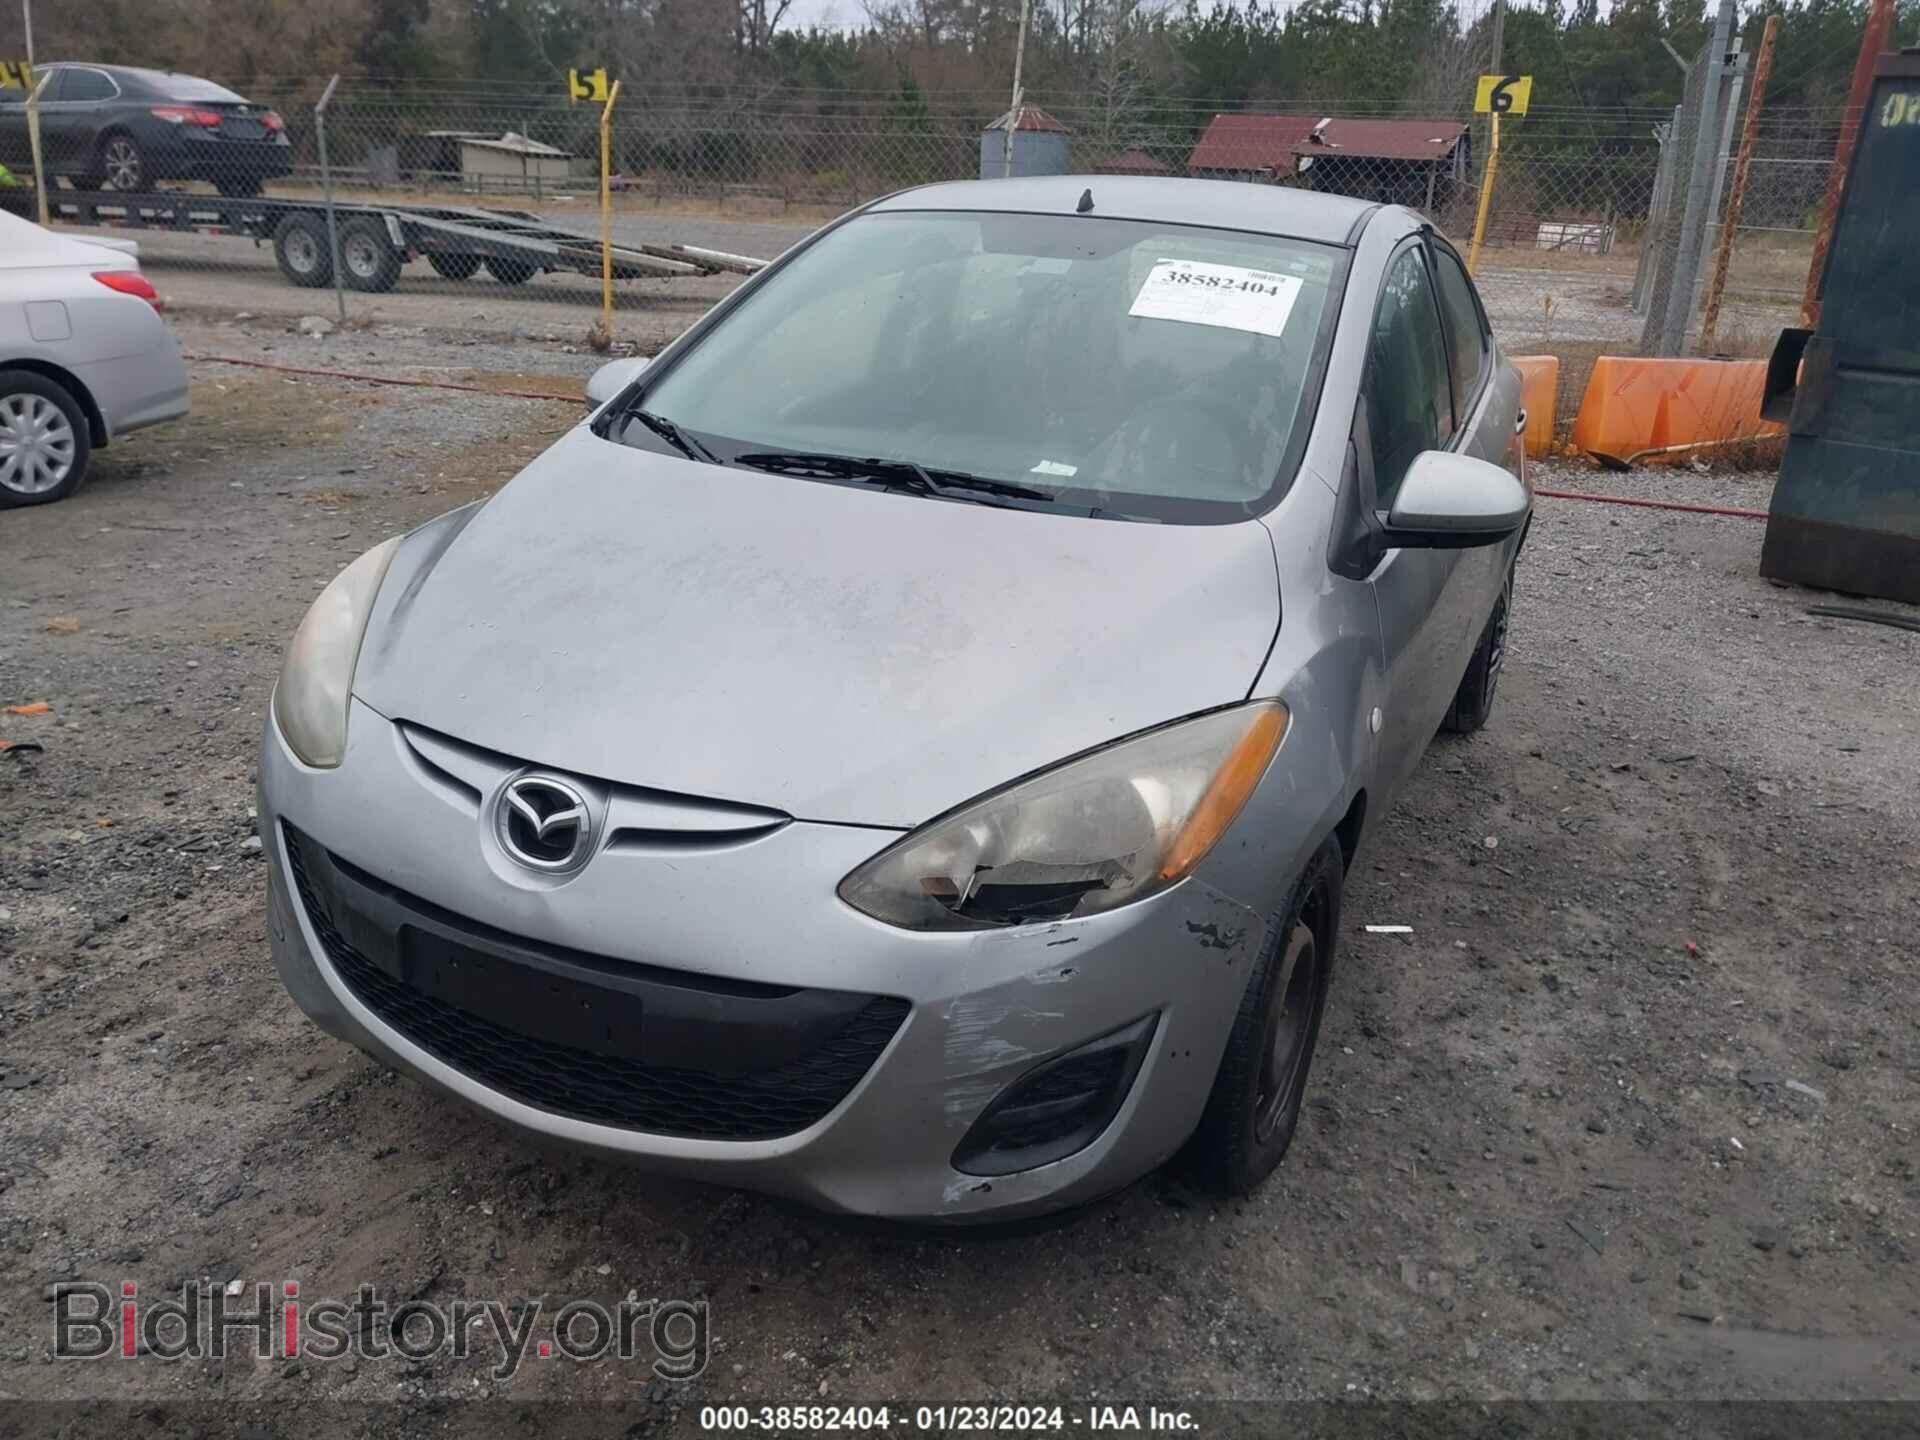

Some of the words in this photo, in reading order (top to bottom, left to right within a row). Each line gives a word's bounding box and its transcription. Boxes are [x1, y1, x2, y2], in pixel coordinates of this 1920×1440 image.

[577, 65, 595, 99] 5
[1491, 73, 1520, 112] 6
[1162, 270, 1279, 297] 38582404
